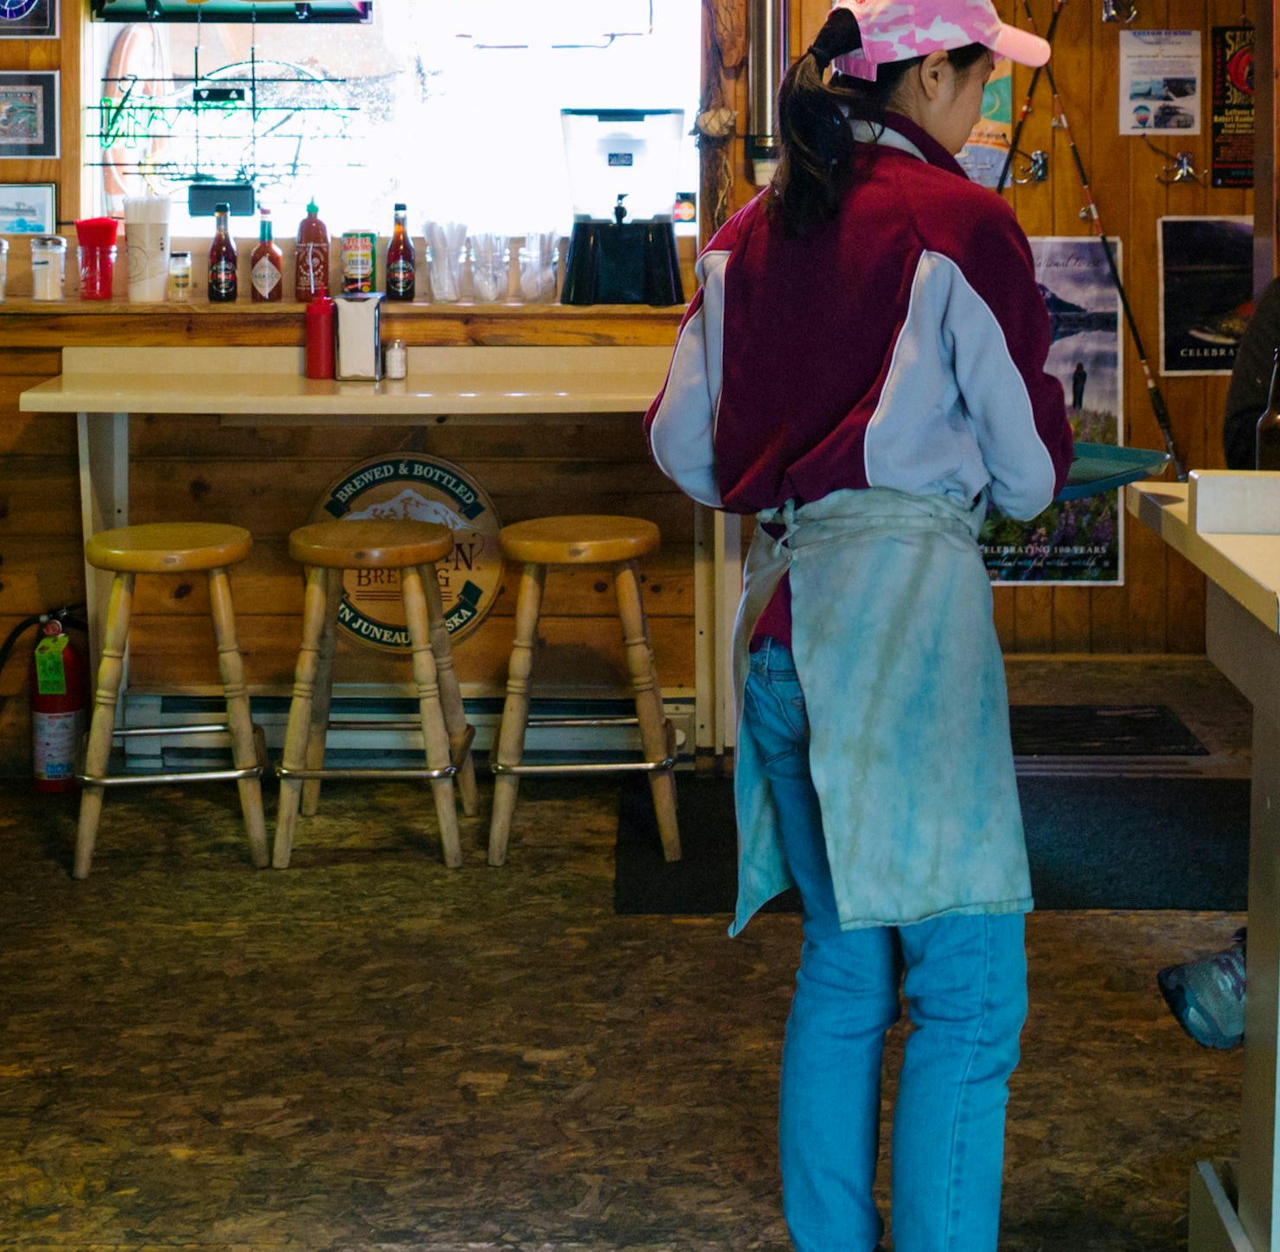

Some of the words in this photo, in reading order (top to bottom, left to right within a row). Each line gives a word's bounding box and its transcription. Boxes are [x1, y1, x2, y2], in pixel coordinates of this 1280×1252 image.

[336, 465, 394, 503] BREWED
[398, 462, 409, 475] &
[412, 464, 476, 504] BOTTLED
[978, 545, 1049, 555] ELEBRATING
[352, 616, 411, 644] JUNEAU
